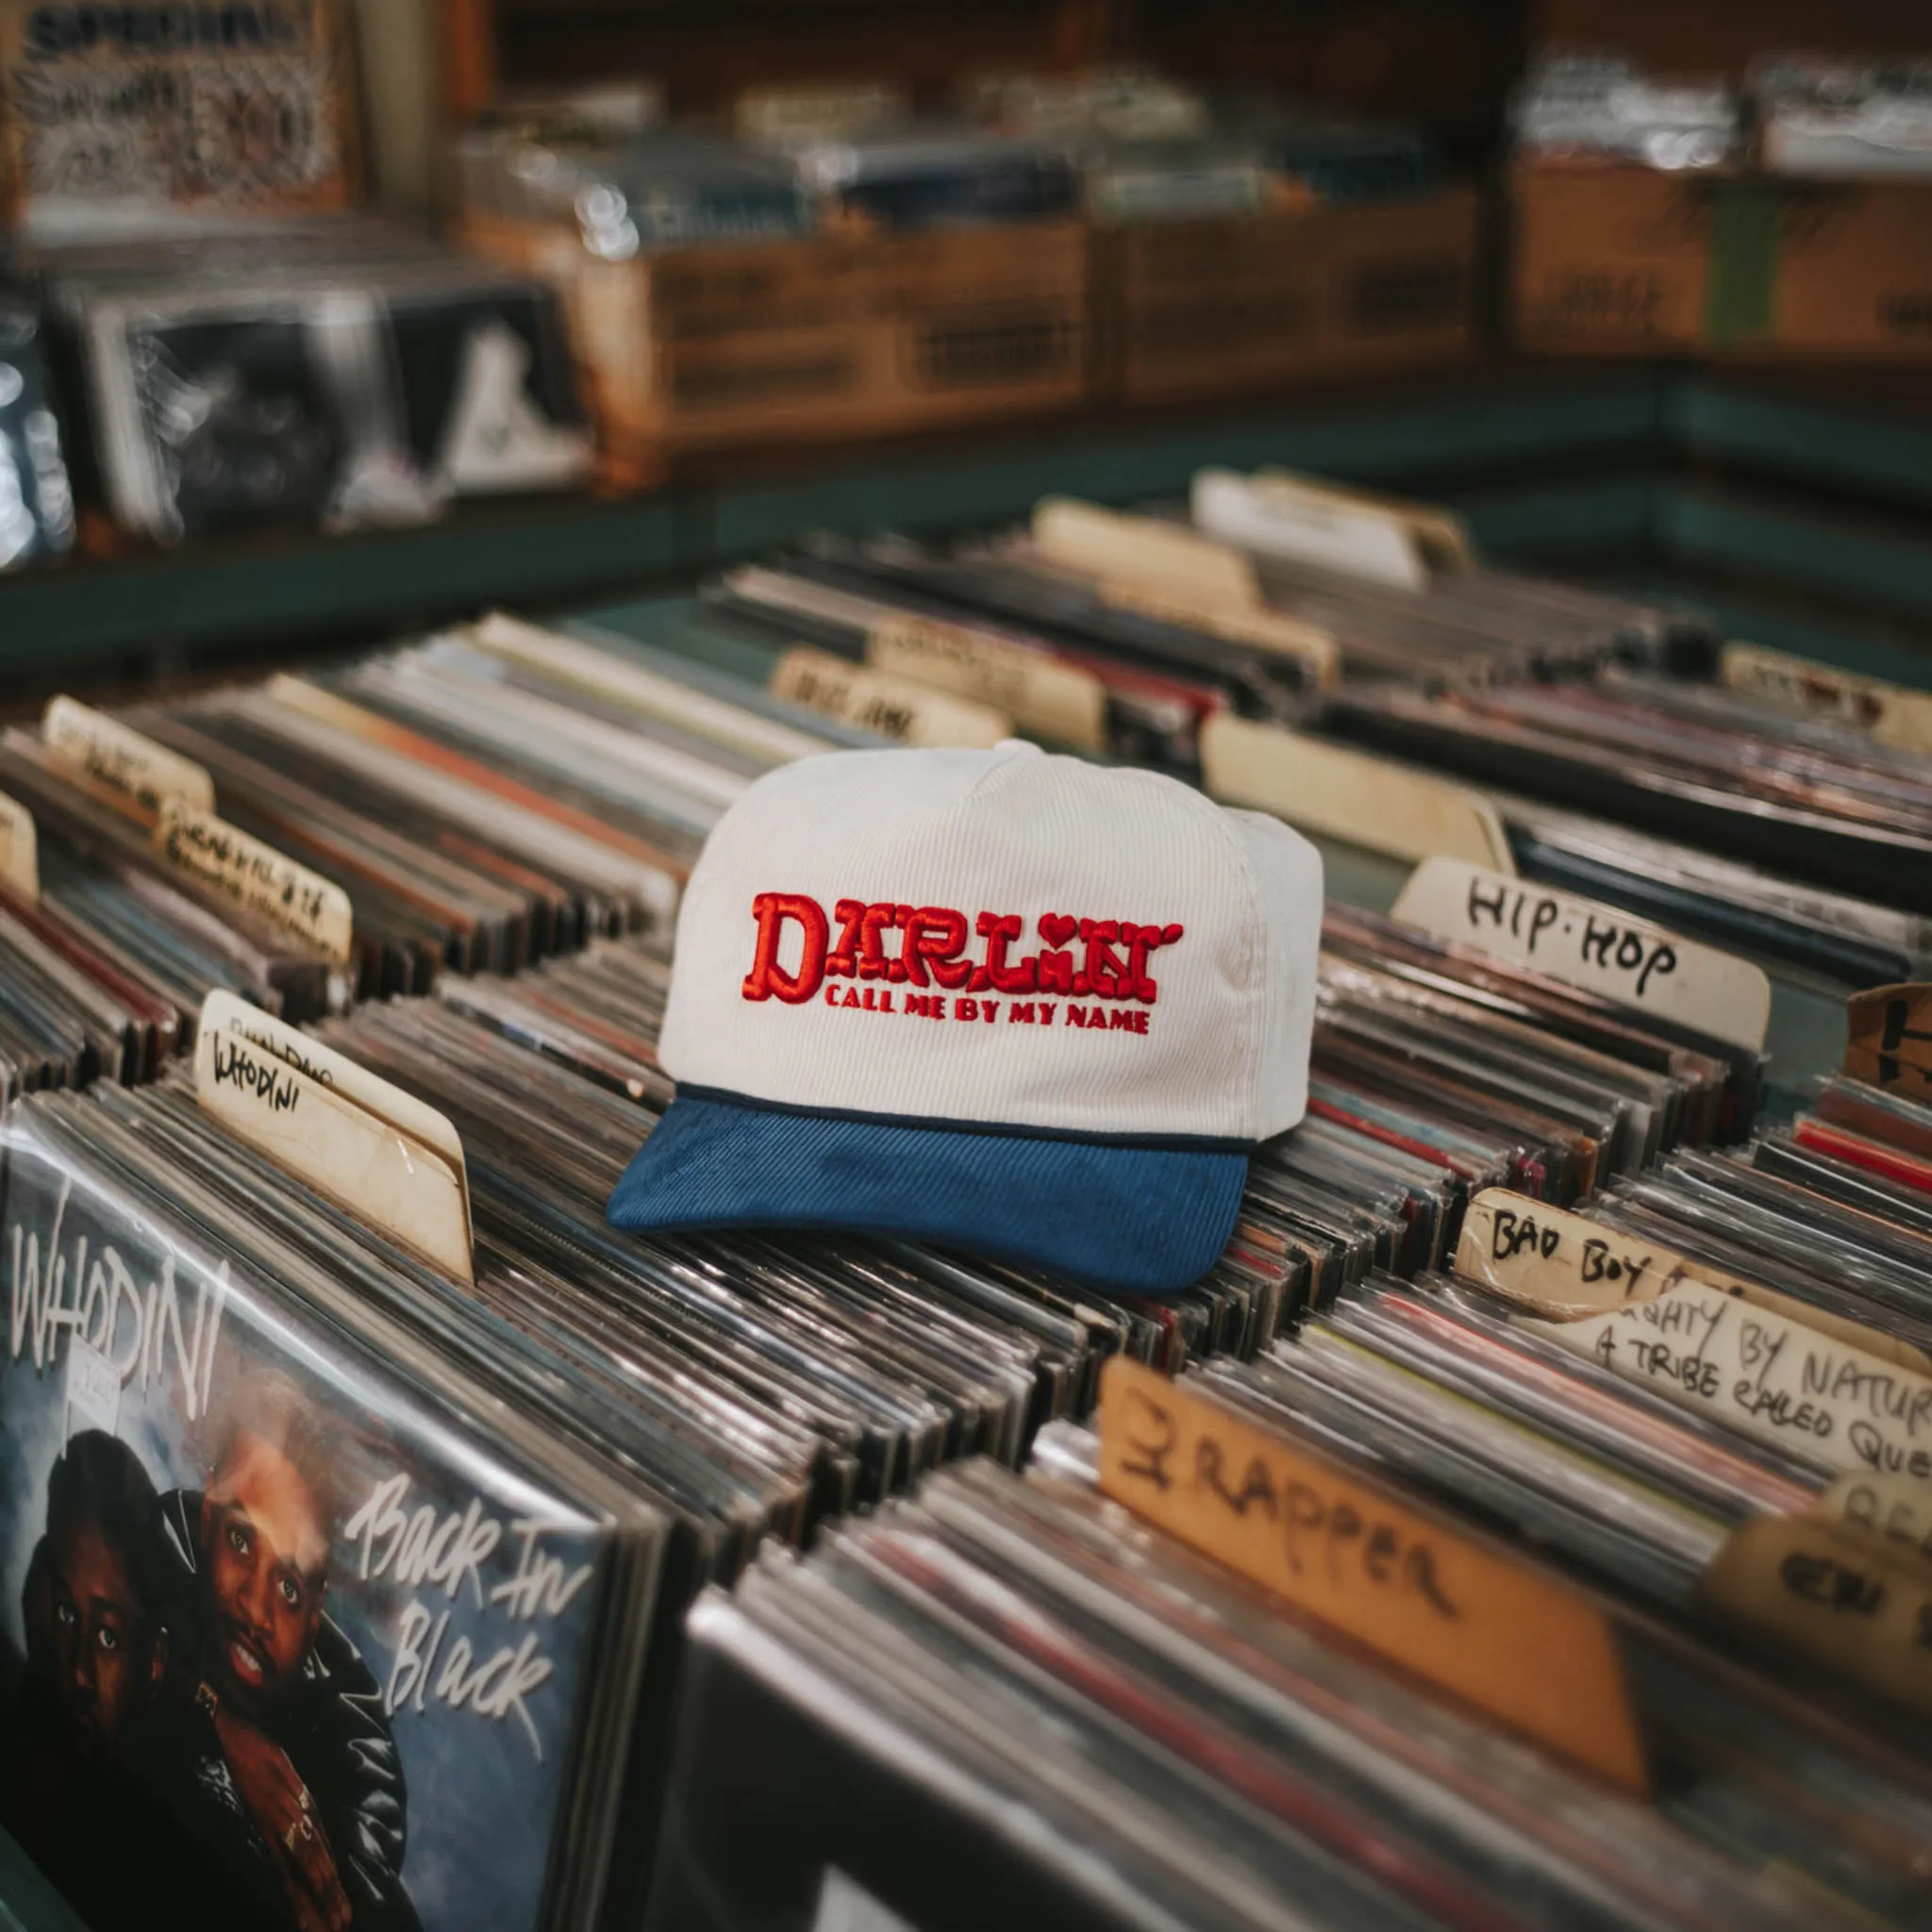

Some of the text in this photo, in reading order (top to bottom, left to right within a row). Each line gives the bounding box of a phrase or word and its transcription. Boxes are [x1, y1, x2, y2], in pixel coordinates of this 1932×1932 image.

[213, 1030, 300, 1112] WHODINI
[824, 984, 1150, 1035] CALL ME BY MY NAME
[10, 1175, 230, 1422] WHODINI
[1492, 1209, 1560, 1261] BAD
[1581, 1239, 1652, 1298] BOY
[1595, 1324, 1617, 1370] A
[1628, 1338, 1720, 1398] TRIBE
[1847, 1420, 1932, 1478] QUE
[1740, 1320, 1789, 1391] BY
[1802, 1350, 1932, 1438] NATUR
[343, 1473, 502, 1610] Back
[384, 1598, 556, 1762] Black
